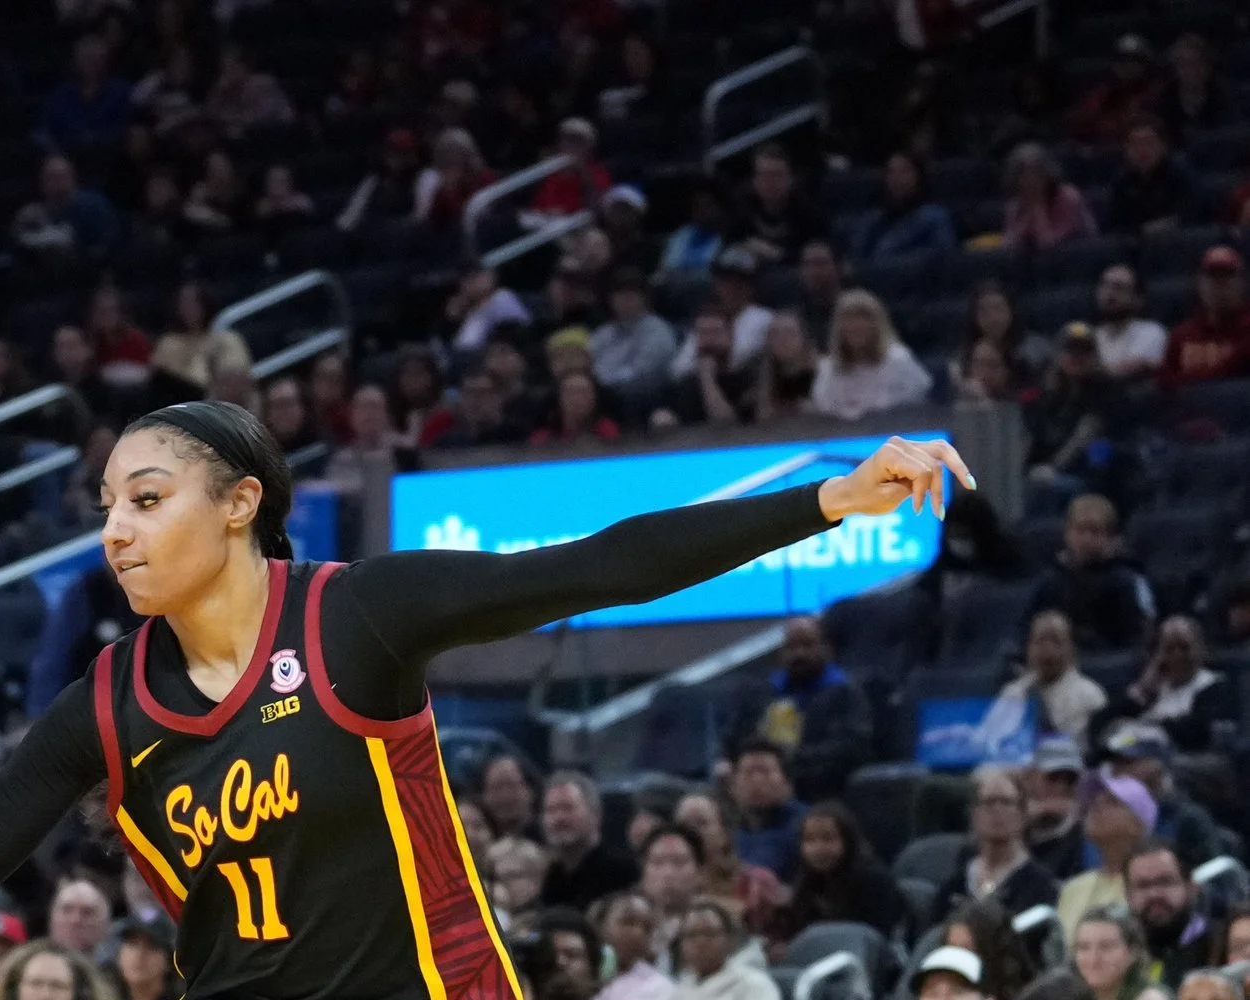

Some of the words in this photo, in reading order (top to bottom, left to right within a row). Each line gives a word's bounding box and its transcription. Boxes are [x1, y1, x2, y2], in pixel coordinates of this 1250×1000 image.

[166, 784, 218, 868] So
[221, 753, 299, 842] Cal
[216, 857, 290, 941] 11
